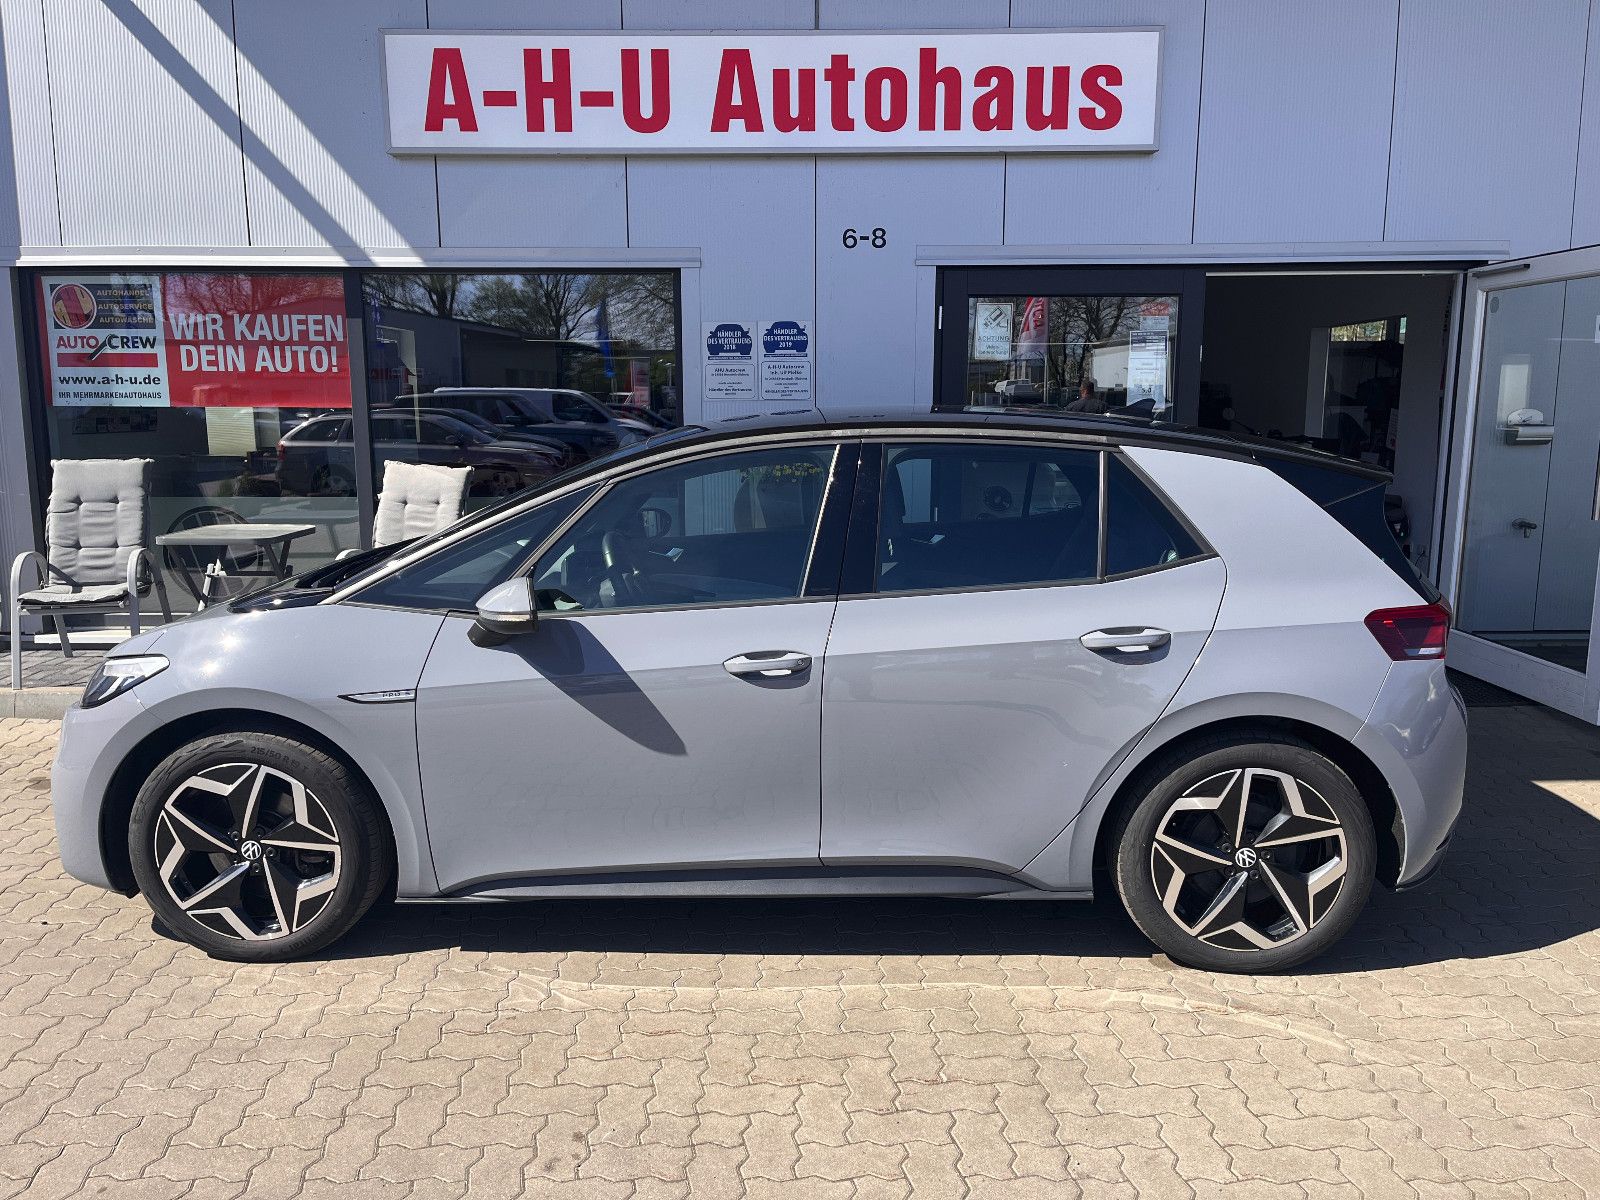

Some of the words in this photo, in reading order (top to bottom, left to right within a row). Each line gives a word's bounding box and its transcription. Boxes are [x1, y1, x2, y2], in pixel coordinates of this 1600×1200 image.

[425, 47, 671, 134] A-H-U
[710, 47, 1123, 134] Autohaus
[842, 227, 887, 248] 6-8
[168, 313, 225, 340] WIR
[233, 314, 344, 342] KAUFEN
[56, 335, 100, 349] AUTO
[106, 334, 157, 349] CREW
[707, 337, 718, 345] DES
[718, 337, 752, 345] VERTRAUENS
[180, 344, 246, 372] DEIN
[254, 345, 339, 373] AUTO!
[58, 373, 161, 386] www.a-h-u.de
[58, 391, 71, 399] IHR
[73, 391, 162, 399] MEHRMARKENAUTOHAUS
[250, 746, 282, 760] 215/50
